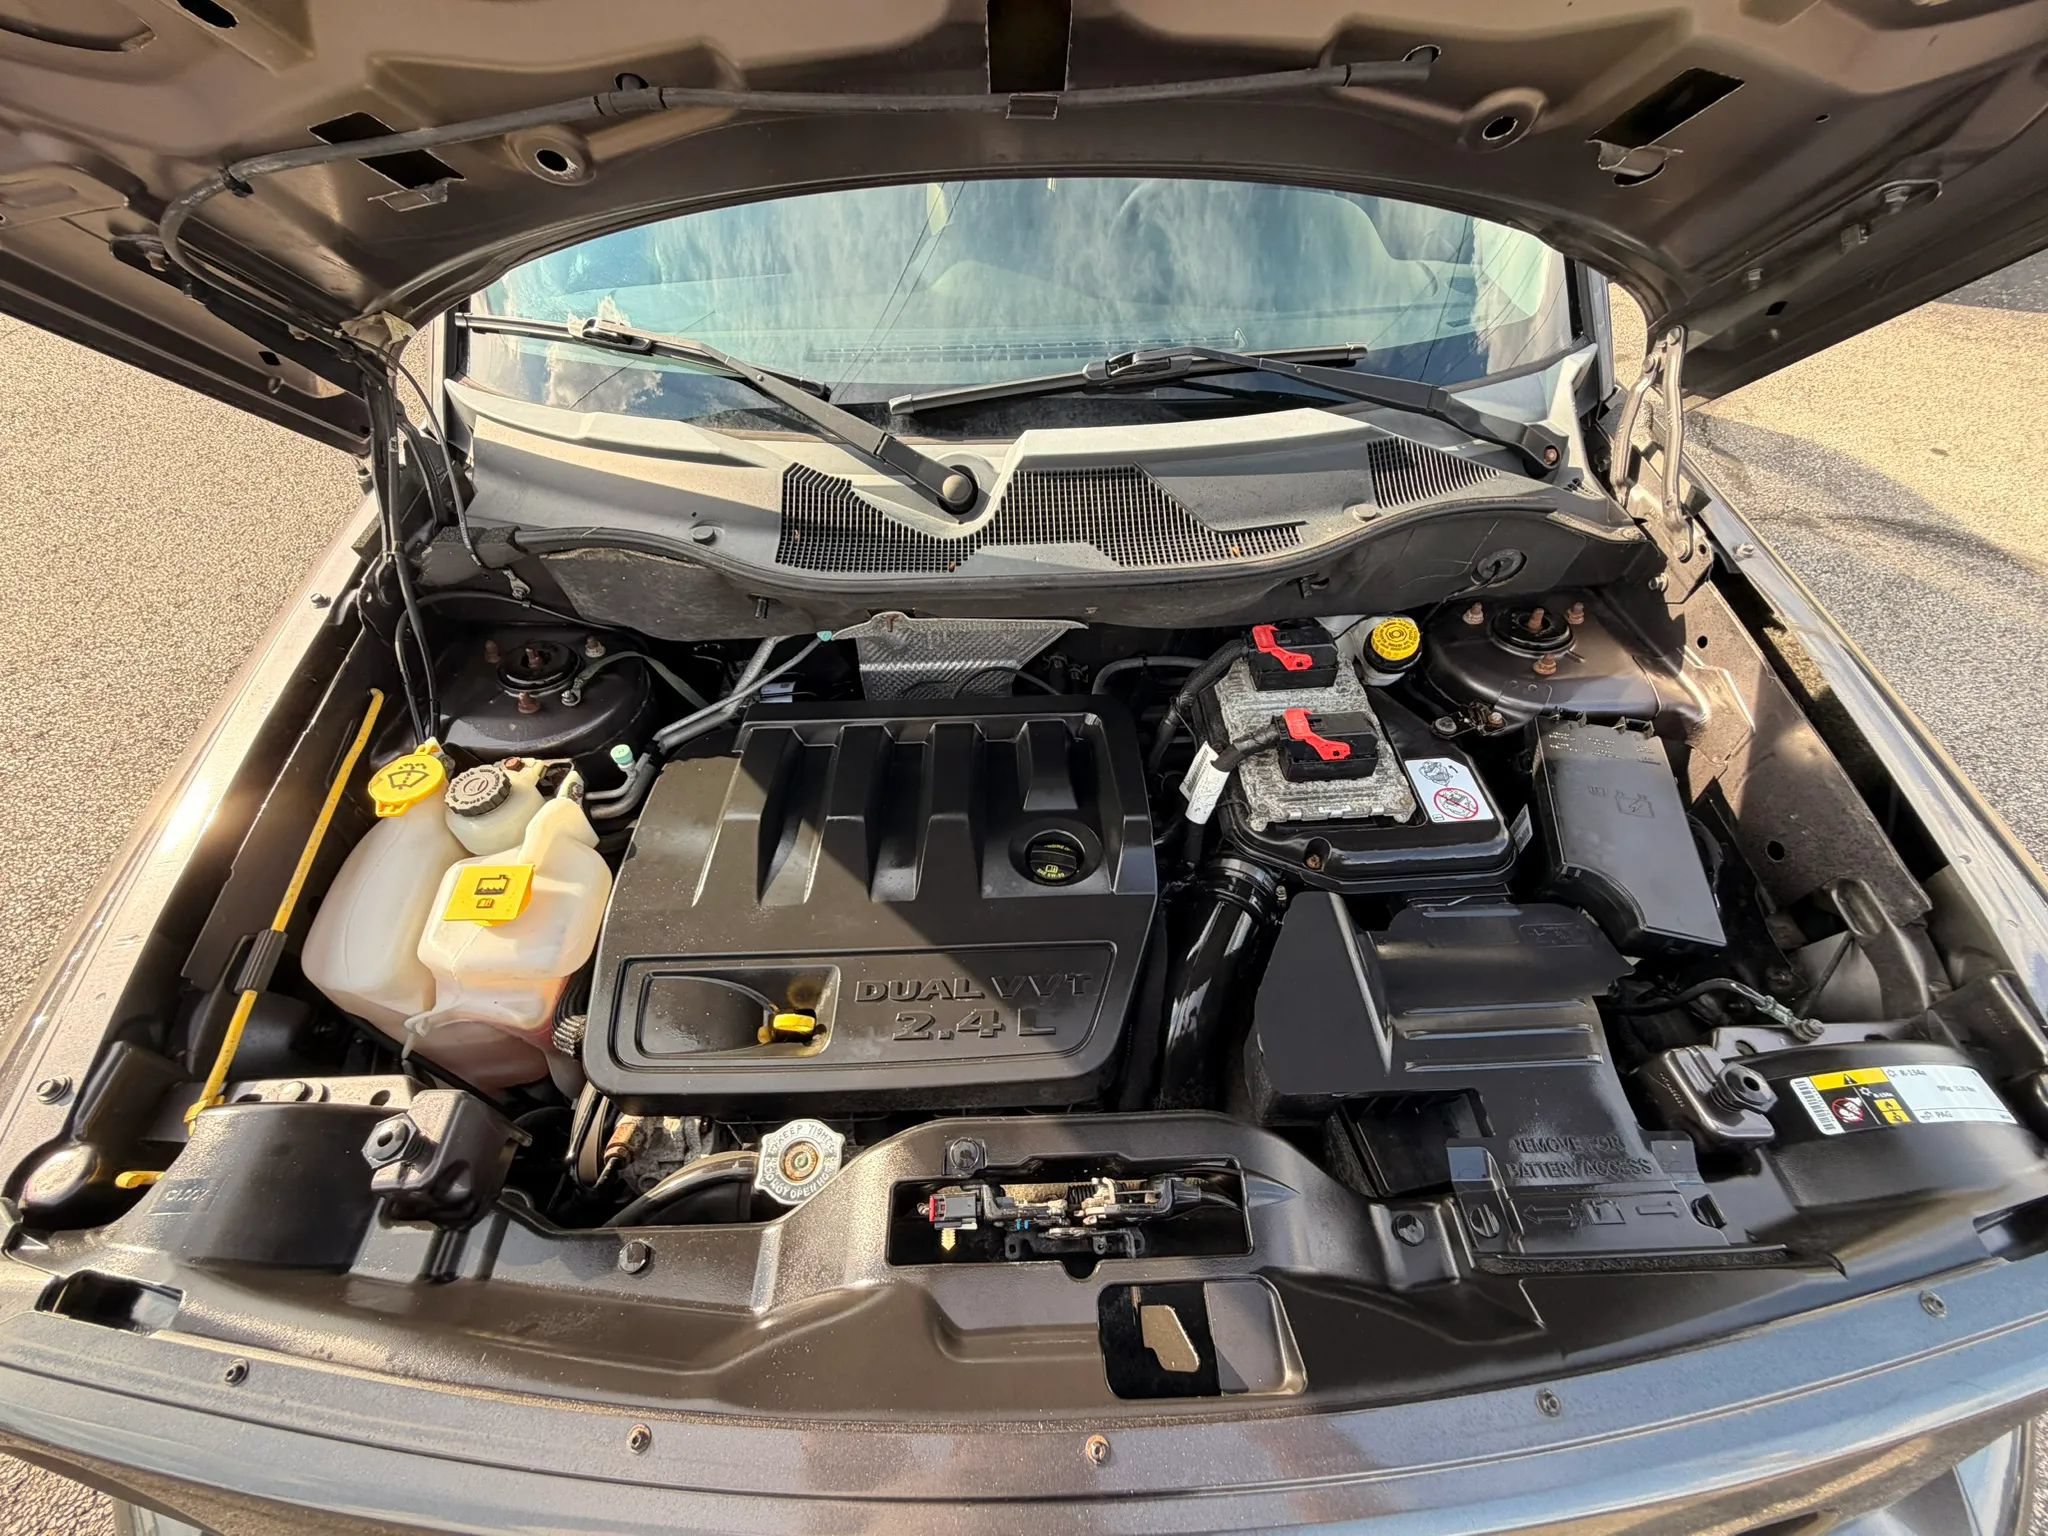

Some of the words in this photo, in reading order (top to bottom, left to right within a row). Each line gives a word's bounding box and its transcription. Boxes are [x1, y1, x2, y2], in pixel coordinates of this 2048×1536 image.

[856, 977, 985, 1003] DUAL
[991, 974, 1092, 998] VVT
[778, 1124, 803, 1142] KEEP
[1509, 1135, 1582, 1153] REMOVE
[1506, 1160, 1579, 1179] BATTERY
[1584, 1158, 1653, 1177] ACCESS
[789, 1185, 817, 1199] OPEN
